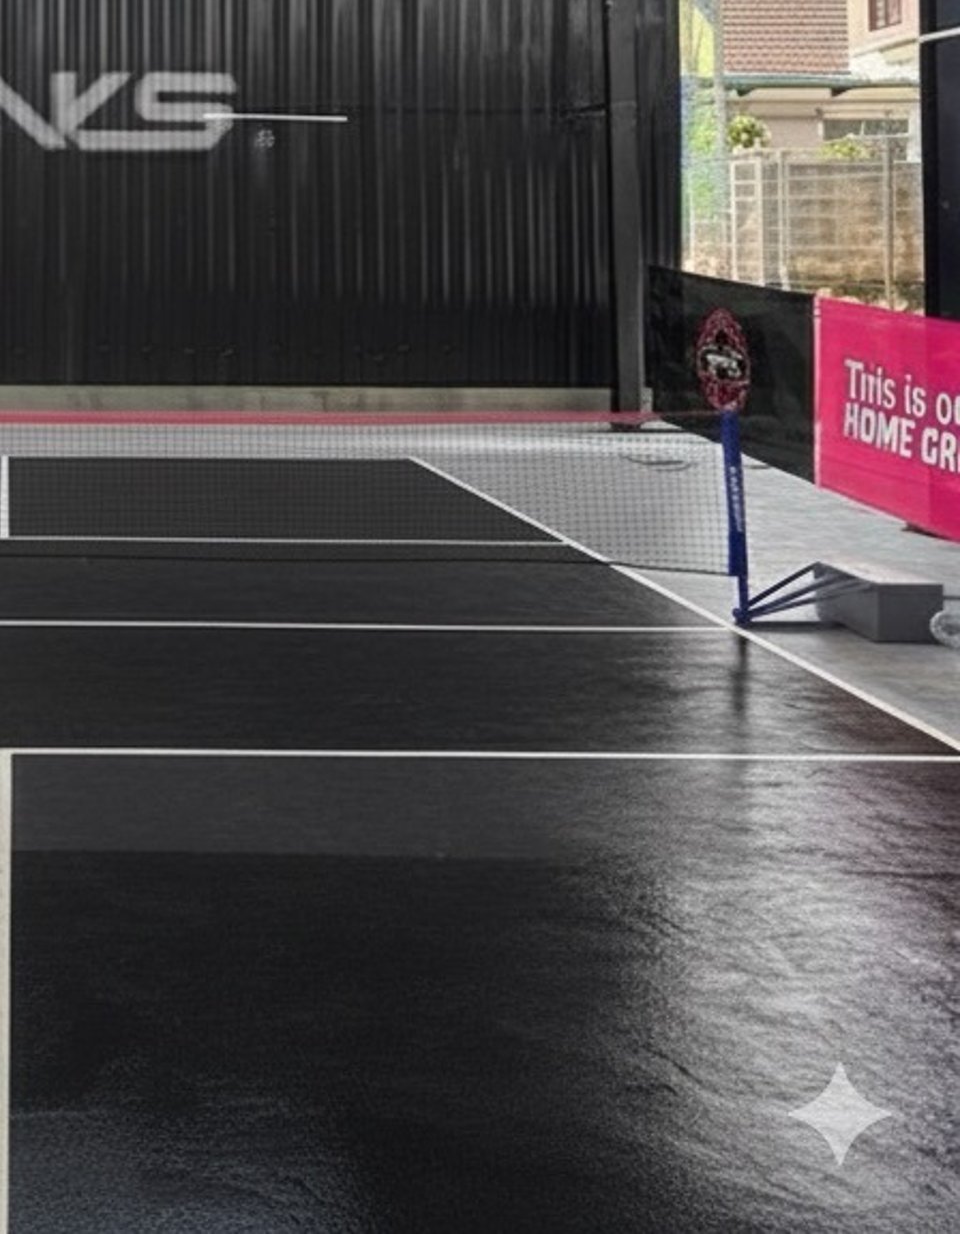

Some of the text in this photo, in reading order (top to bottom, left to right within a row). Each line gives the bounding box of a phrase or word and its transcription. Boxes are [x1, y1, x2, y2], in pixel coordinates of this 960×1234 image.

[905, 374, 926, 417] is
[844, 403, 960, 474] HOME GR
